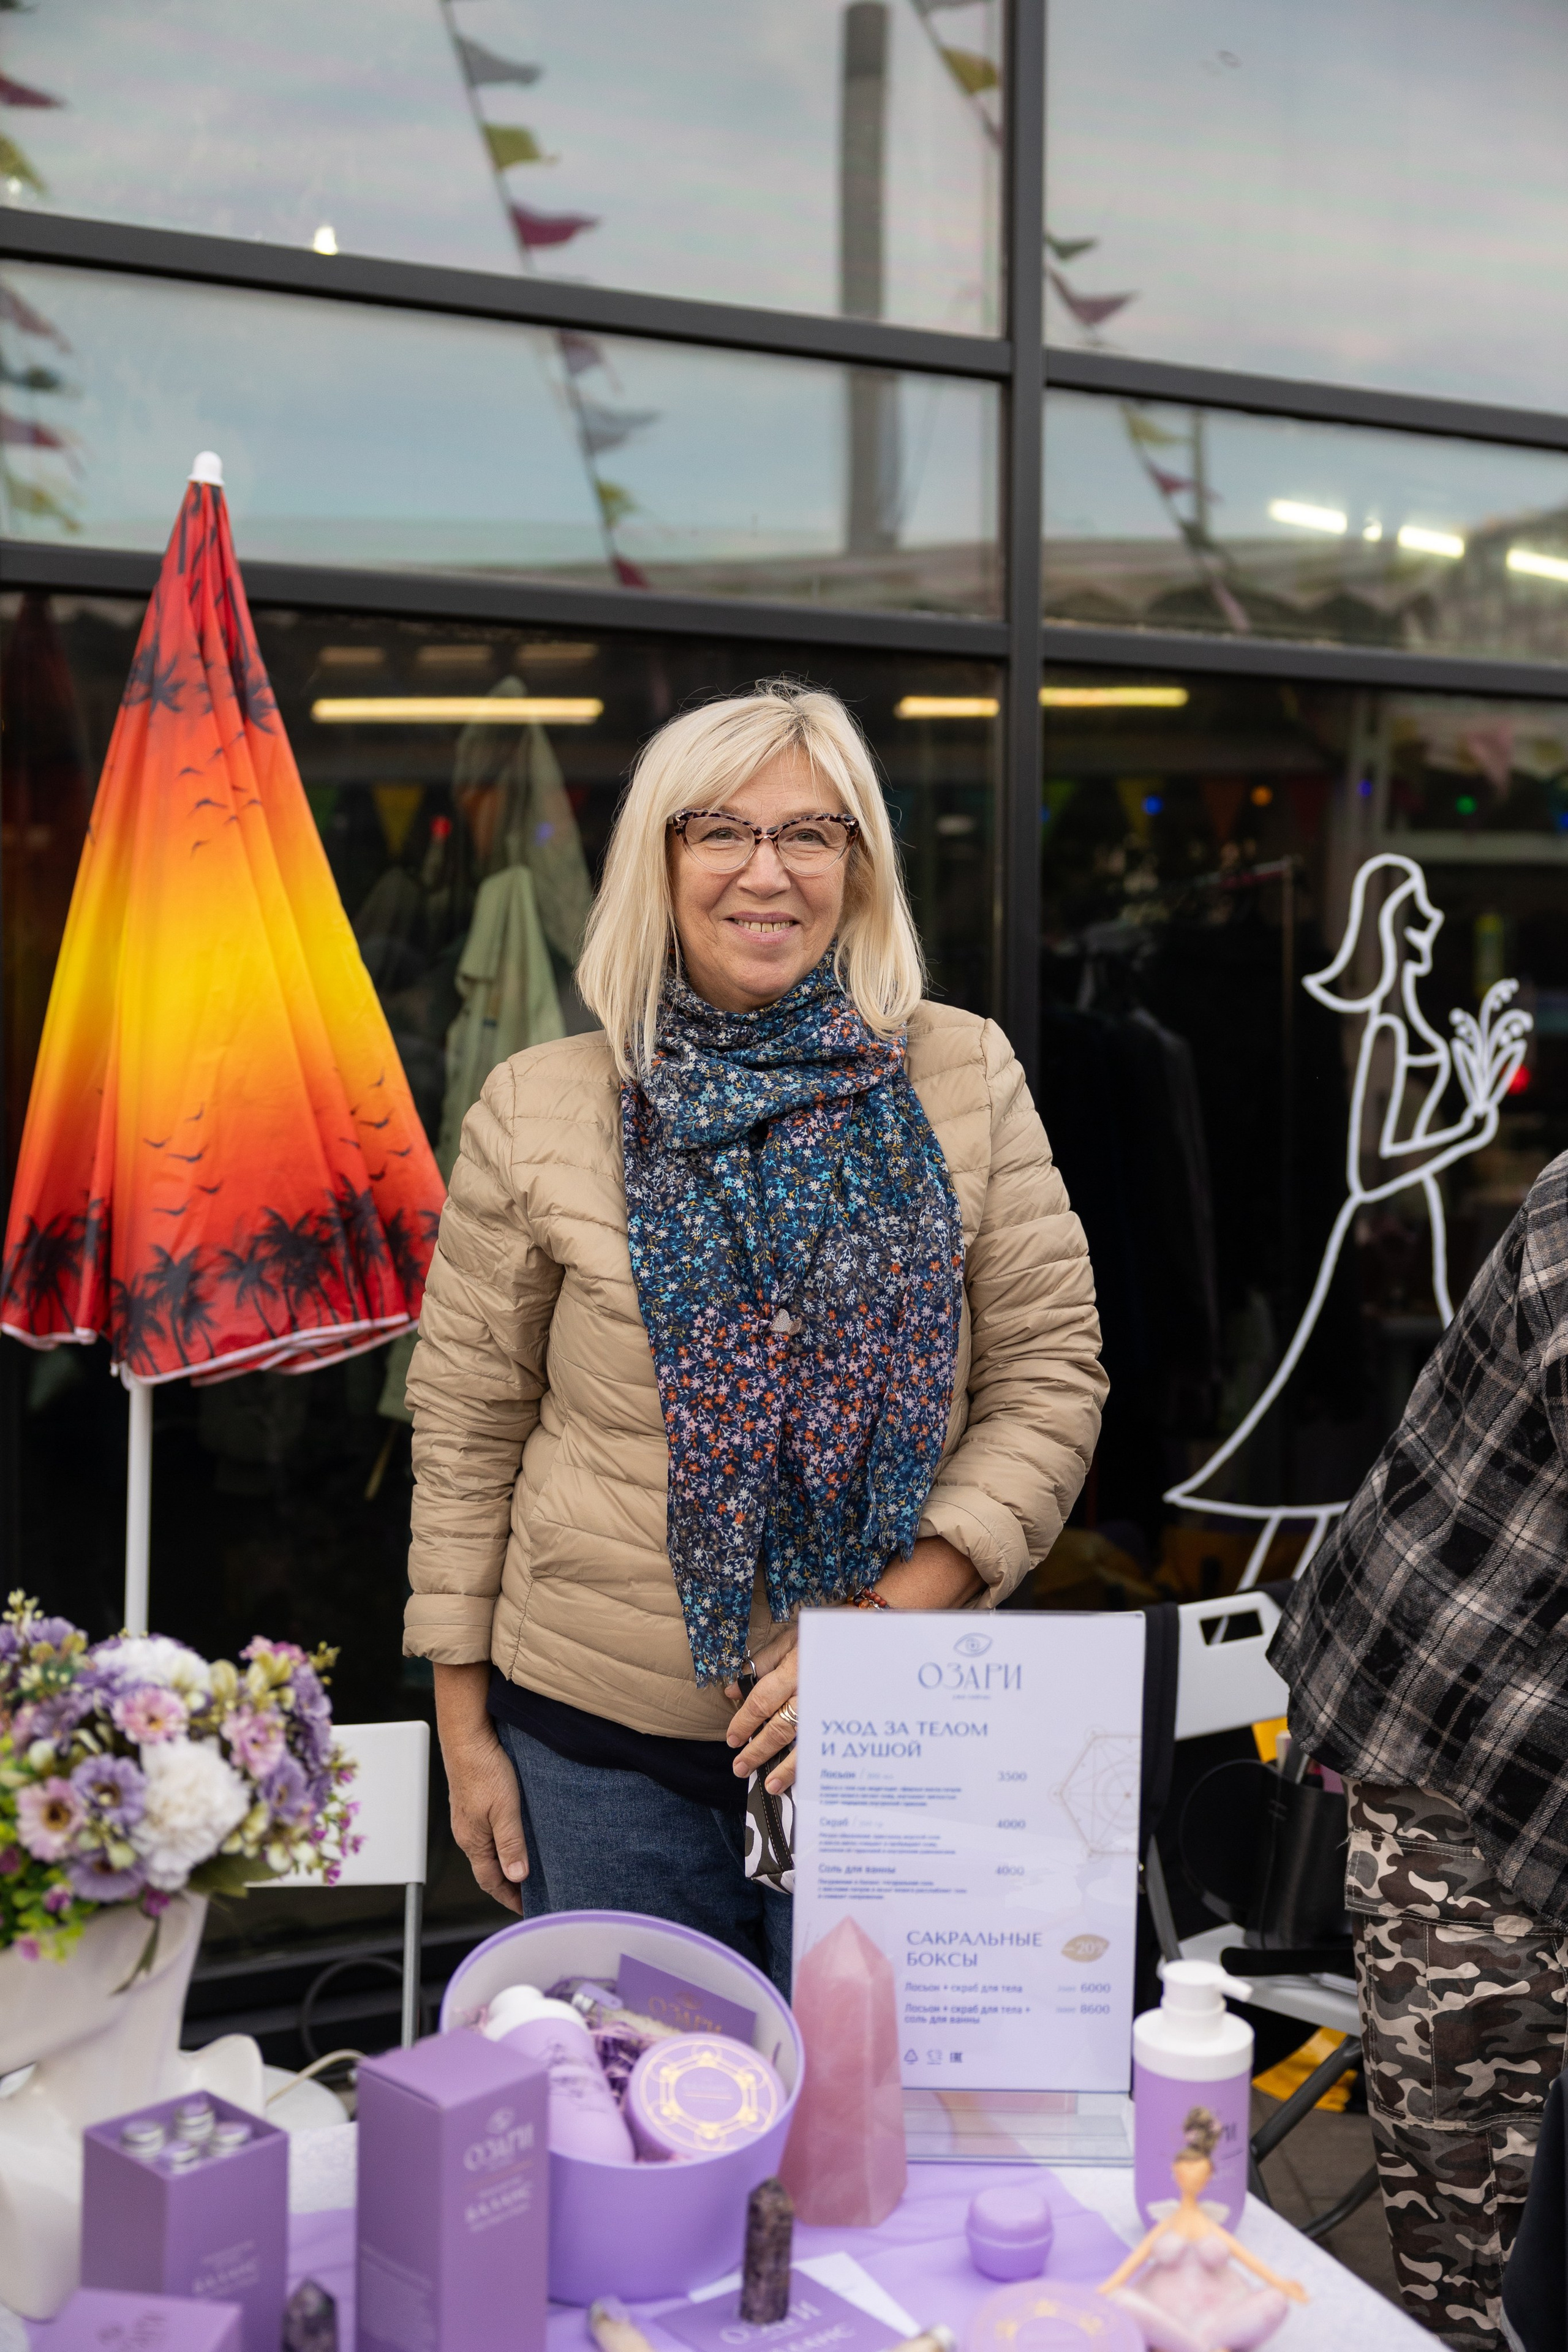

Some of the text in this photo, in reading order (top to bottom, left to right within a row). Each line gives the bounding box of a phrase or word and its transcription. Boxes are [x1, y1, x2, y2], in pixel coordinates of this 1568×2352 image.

[918, 1662, 1022, 1690] ОЗАРИ
[821, 1720, 988, 1738] УХОД ЗА ТЕЛОМ
[821, 1740, 921, 1758] И ДУШОЙ
[998, 1771, 1027, 1782] 3500
[997, 1820, 1026, 1830] 4000
[818, 1864, 842, 1874] Соль
[996, 1865, 1025, 1875] 4000
[907, 1931, 1043, 1947] САКРАЛЬНЫЕ
[907, 1952, 978, 1967] БОКСЫ
[905, 1983, 940, 1992] Лосьон
[951, 1984, 979, 1994] скраб
[1080, 1983, 1111, 1994] 6000
[905, 2003, 940, 2013] Лосьон
[951, 2005, 979, 2015] скраб
[981, 2007, 998, 2015] для
